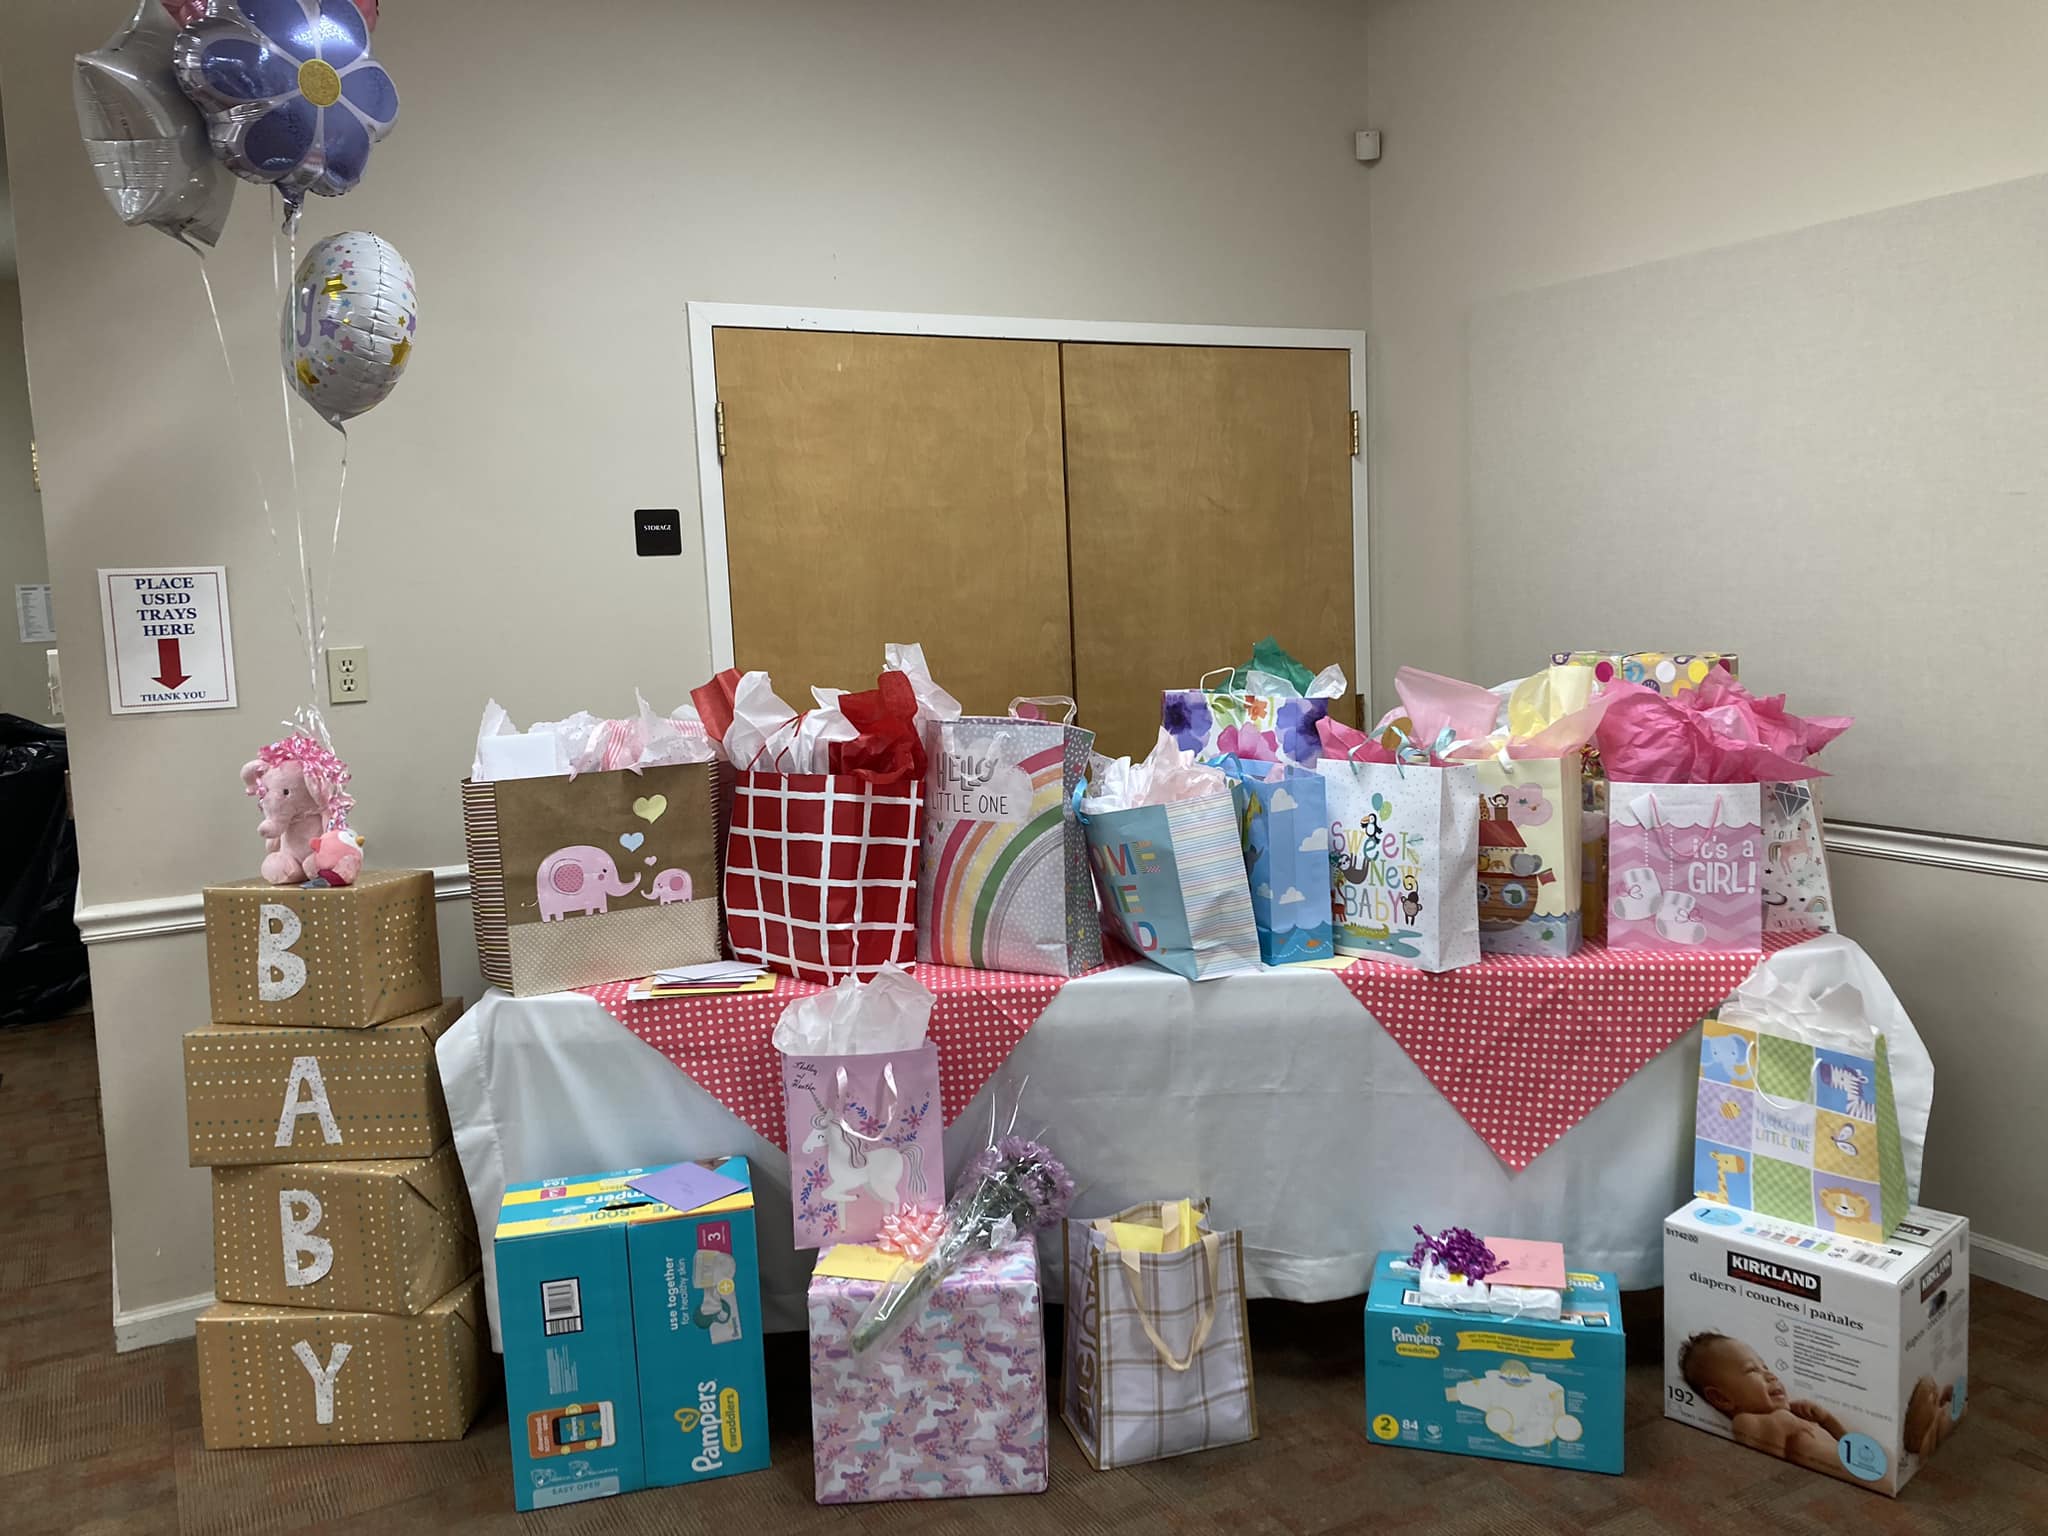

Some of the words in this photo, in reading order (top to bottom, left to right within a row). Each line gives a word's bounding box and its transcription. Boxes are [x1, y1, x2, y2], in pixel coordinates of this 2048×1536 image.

[134, 577, 195, 590] PLACE
[141, 592, 191, 606] USED
[136, 607, 197, 621] TRAYS
[143, 623, 195, 637] HERE
[140, 692, 181, 702] THANK
[183, 690, 207, 700] YOU
[978, 794, 1009, 815] ONE
[1692, 835, 1728, 859] it's
[1742, 839, 1754, 858] a
[1688, 861, 1757, 895] GIRL!
[258, 904, 307, 1001] B
[274, 1056, 343, 1147] A
[280, 1190, 334, 1287] B
[707, 1231, 721, 1242] 3
[664, 1256, 679, 1308] together
[1731, 1255, 1818, 1290] KIRKLAND
[1689, 1271, 1737, 1293] diapers
[1746, 1288, 1800, 1313] couches
[1809, 1307, 1864, 1331] pañales
[669, 1310, 679, 1331] use
[1391, 1326, 1442, 1347] Pampers
[291, 1339, 352, 1424] Y
[1668, 1385, 1695, 1407] 192
[691, 1379, 723, 1472] Pampers
[725, 1392, 738, 1448] swaddlers
[1380, 1417, 1392, 1431] 2
[1402, 1419, 1418, 1431] 84
